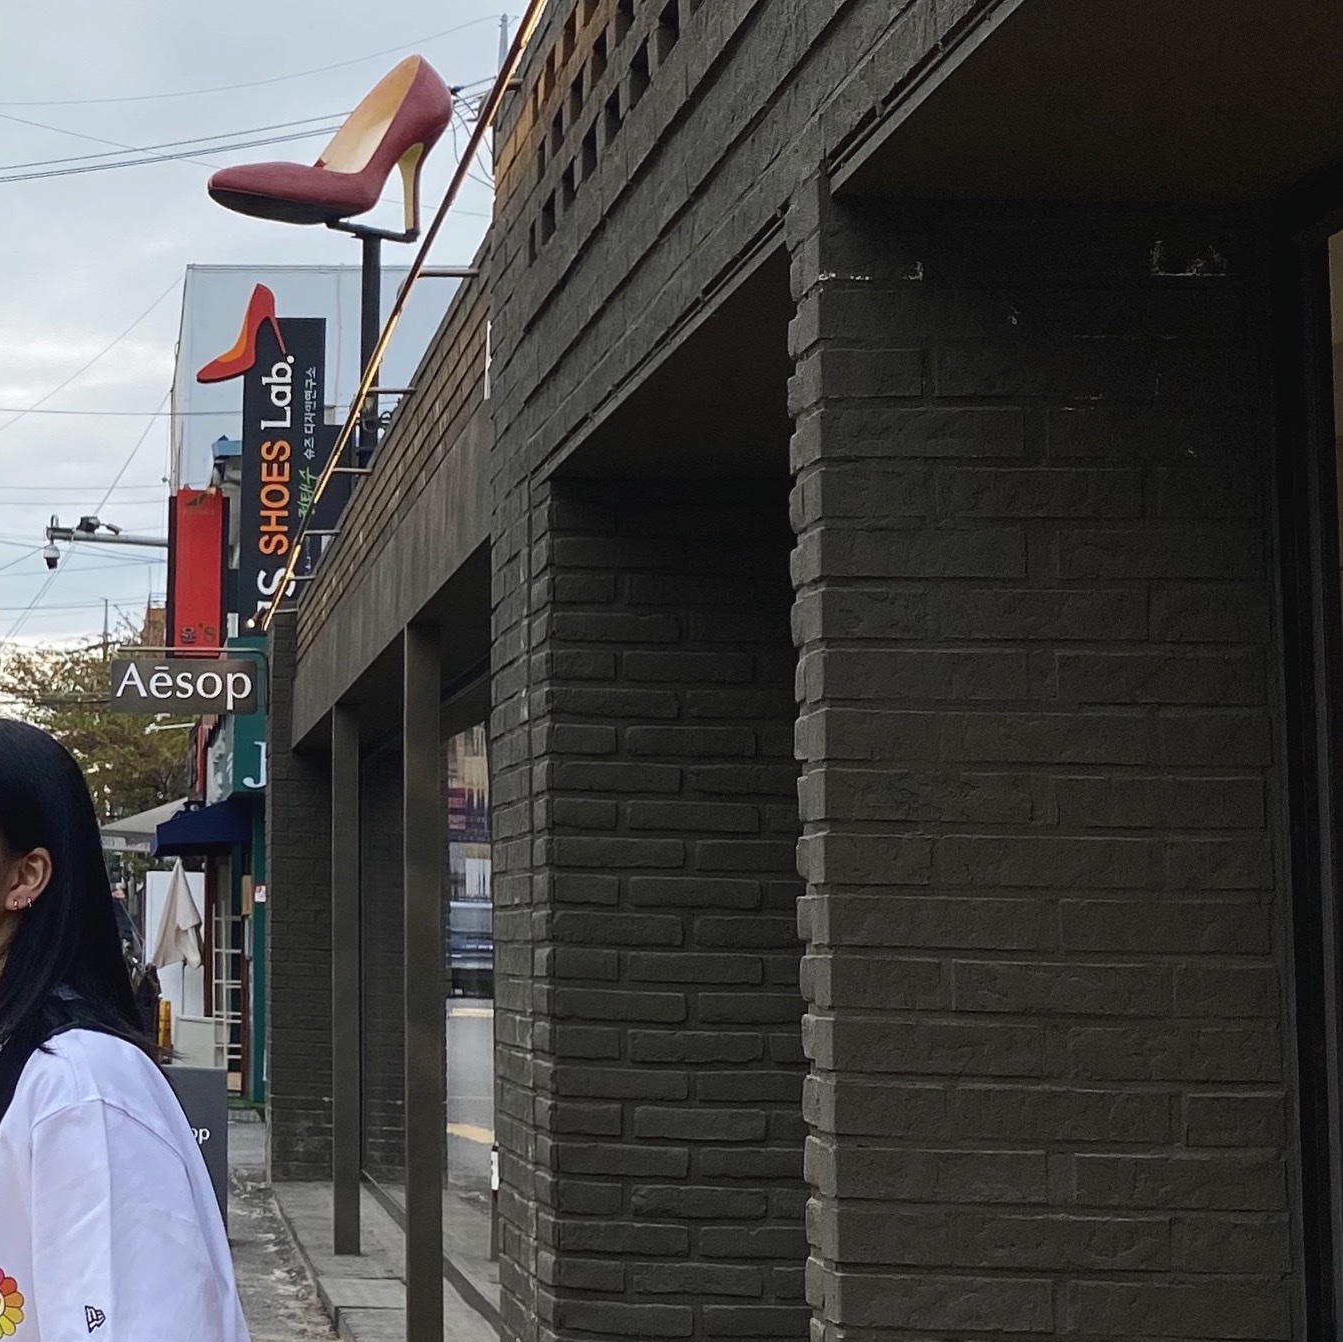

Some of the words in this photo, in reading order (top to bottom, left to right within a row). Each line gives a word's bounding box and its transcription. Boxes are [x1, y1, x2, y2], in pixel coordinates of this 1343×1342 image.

[260, 354, 295, 430] Lab.
[303, 366, 317, 434] 디자인연구소
[259, 439, 291, 556] SHOES
[116, 662, 252, 711] Aēsop
